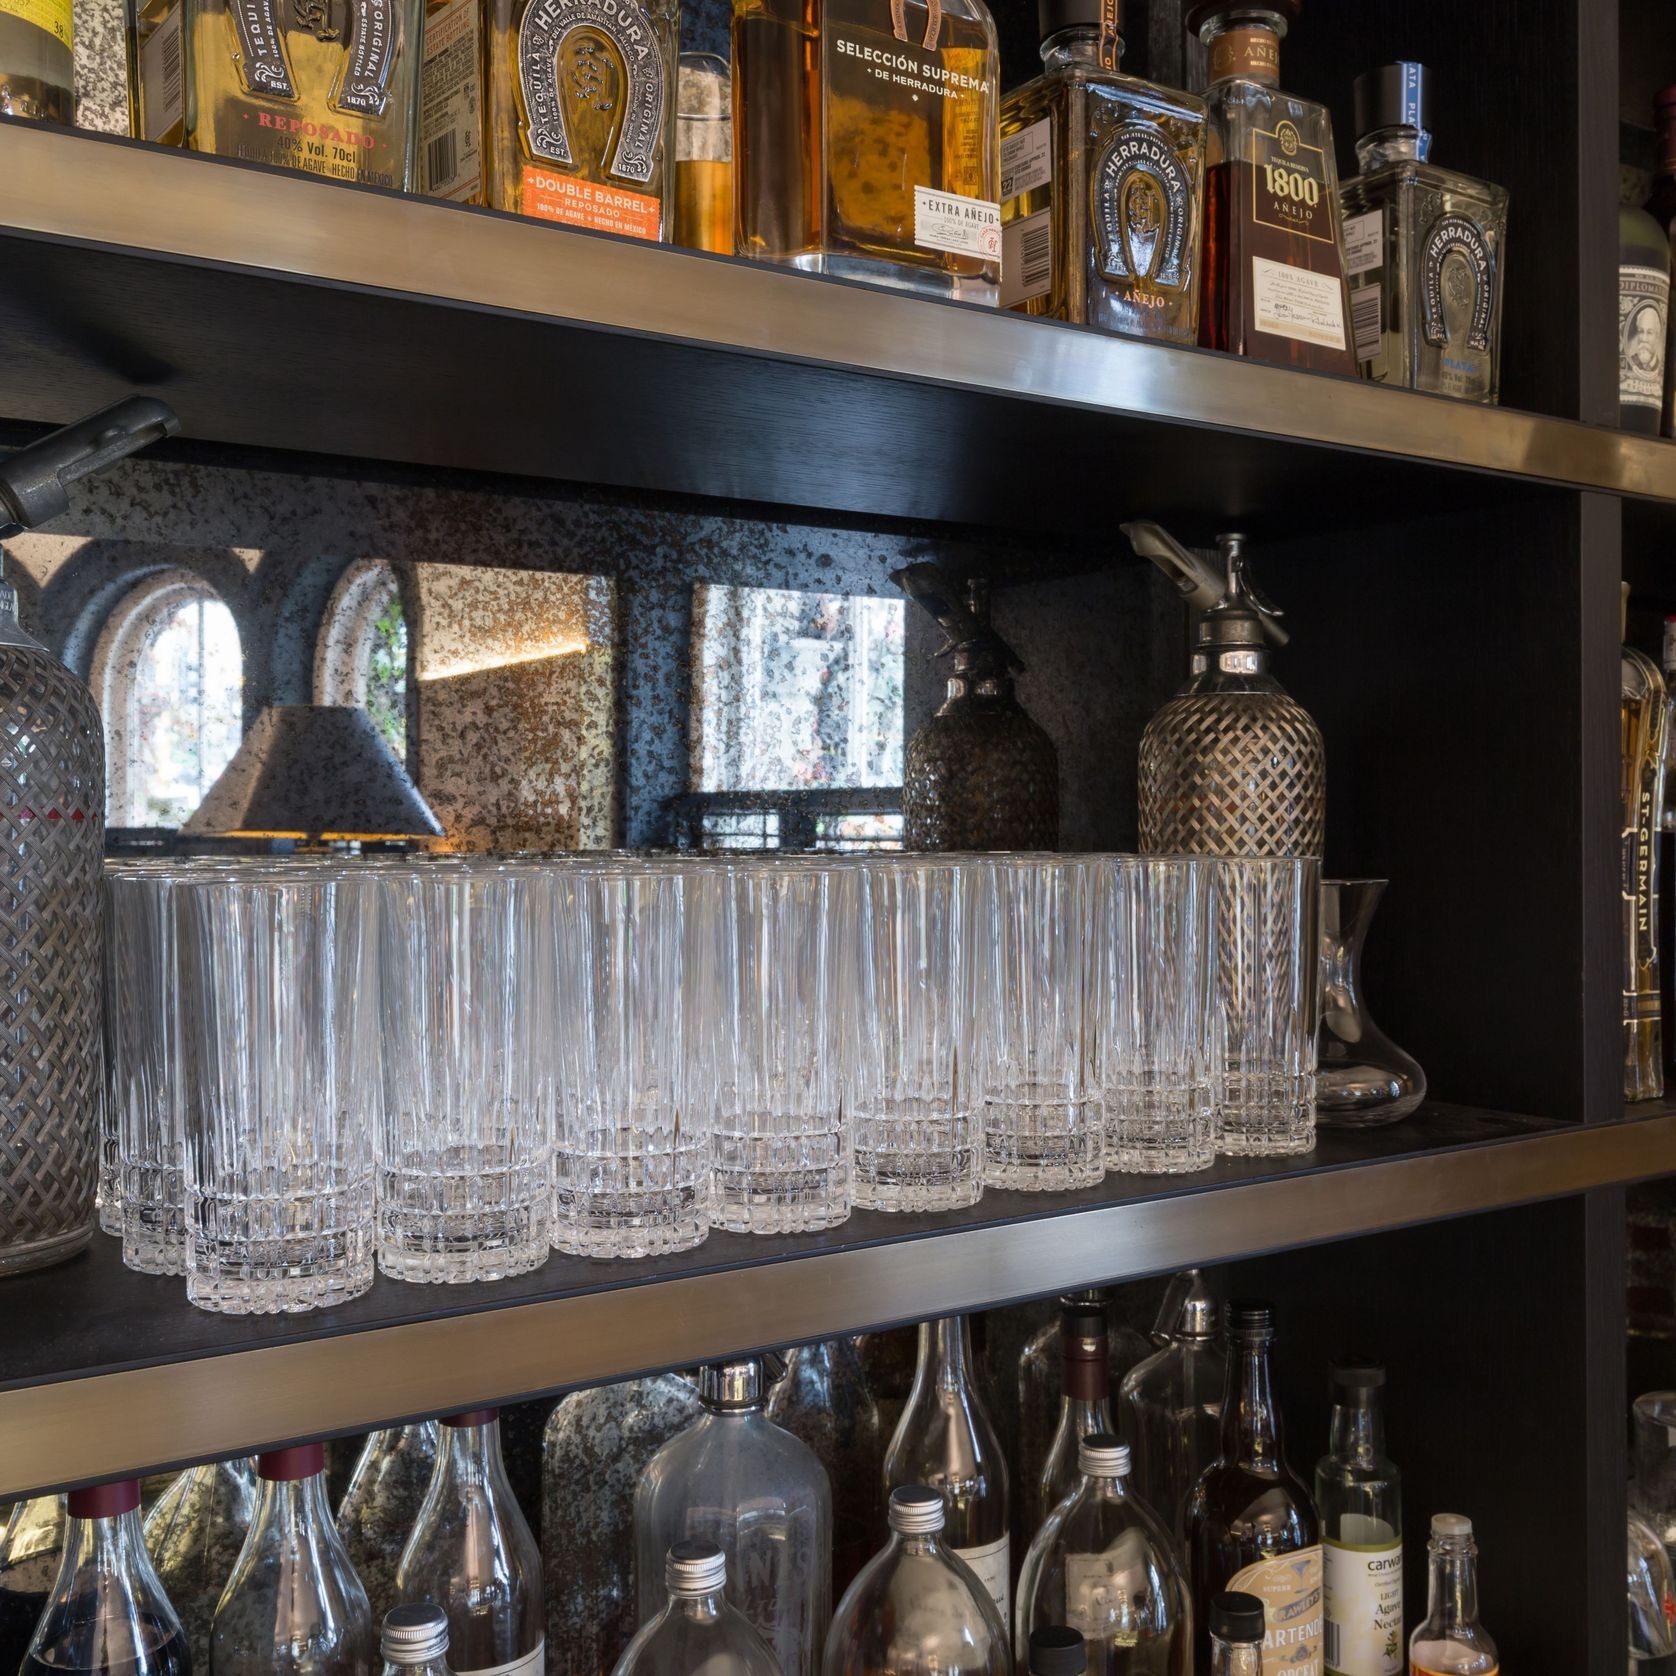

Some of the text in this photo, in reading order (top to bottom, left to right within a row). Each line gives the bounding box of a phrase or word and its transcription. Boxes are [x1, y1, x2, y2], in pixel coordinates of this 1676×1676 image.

[263, 0, 272, 23] AGAV
[54, 20, 64, 39] 38
[354, 18, 368, 77] ESTATE BOTTLED
[364, 10, 384, 78] ORIGINAL
[1244, 44, 1279, 65] AÑEJ
[836, 39, 989, 94] SELECCIÓN SUPREMA
[1408, 64, 1416, 88] ATA
[270, 81, 290, 91] EST.
[532, 53, 549, 124] TEQUILA
[875, 68, 958, 99] DE HERRADURA
[346, 95, 366, 106] 1870
[635, 82, 654, 148] ORIGINAL
[258, 112, 376, 149] REPOSADO
[277, 136, 356, 164] 40% Vol. 70cl
[550, 146, 567, 156] EST.
[303, 158, 326, 174] AGAVE
[332, 163, 355, 180] HECHO
[618, 163, 635, 174] 1870
[1105, 141, 1181, 192] HERRADURA
[535, 176, 647, 214] DOUBLE BARREL
[1264, 163, 1319, 207] 1800
[565, 198, 620, 218] REPOSADO
[565, 209, 585, 221] AGAVE
[594, 216, 613, 228] HECHO
[928, 199, 994, 224] EXTRA AÑEJO
[1273, 200, 1313, 219] AÑEJO
[1429, 226, 1486, 271] HERRADURA
[1123, 289, 1165, 309] AÑEJO
[1638, 792, 1650, 931] ST-GERMAIN
[1262, 1615, 1323, 1650] ARTEND
